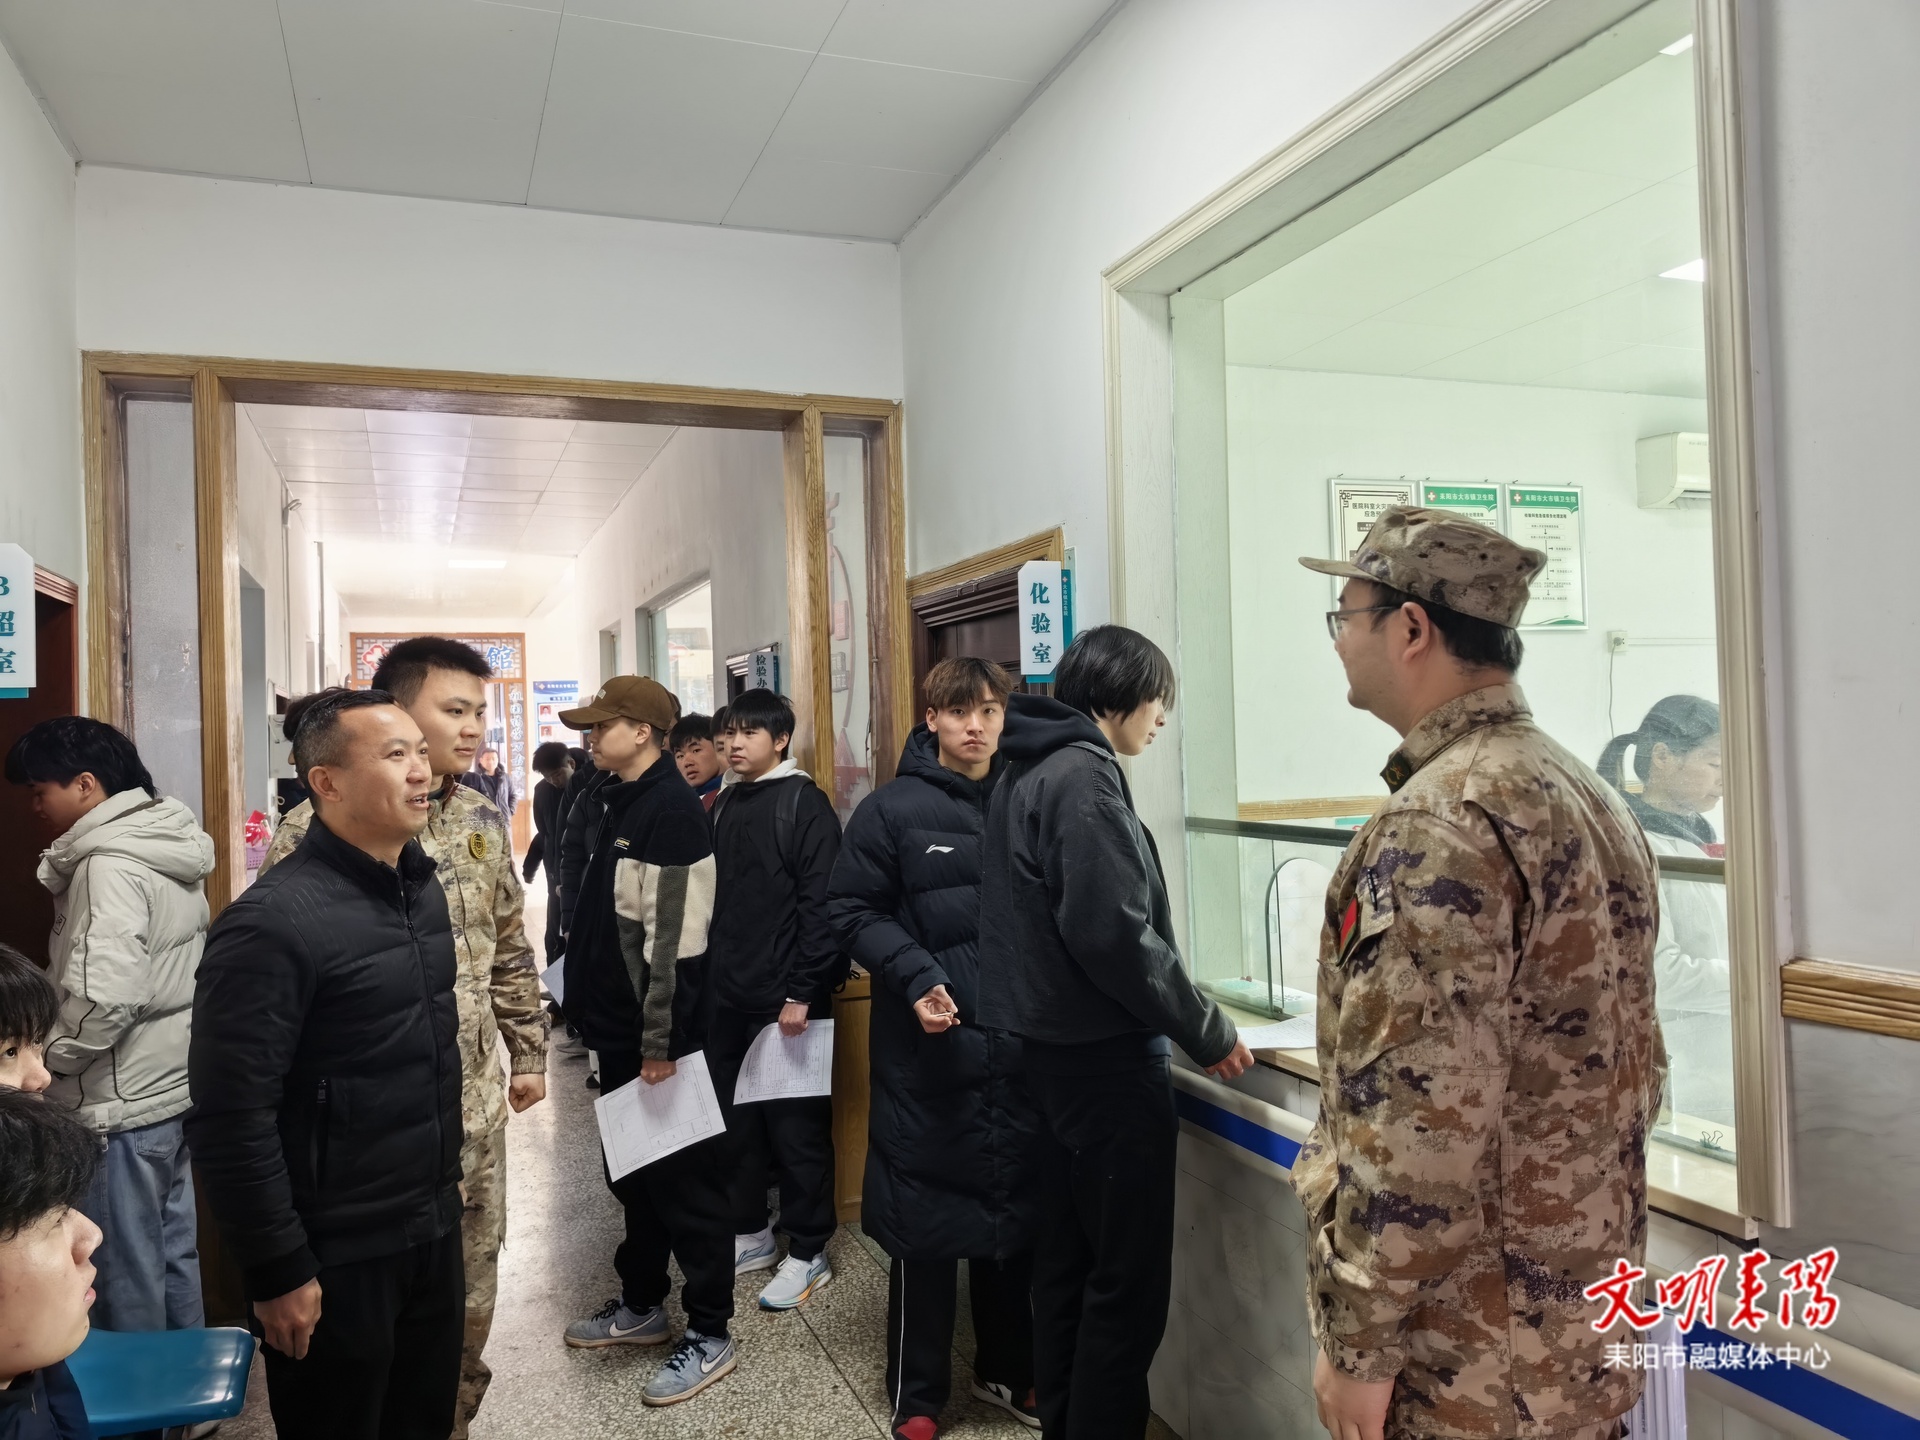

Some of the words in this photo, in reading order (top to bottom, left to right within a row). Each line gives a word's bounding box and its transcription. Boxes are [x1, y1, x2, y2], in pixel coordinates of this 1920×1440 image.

[1030, 582, 1052, 664] 化验室
[756, 654, 767, 688] 检验办
